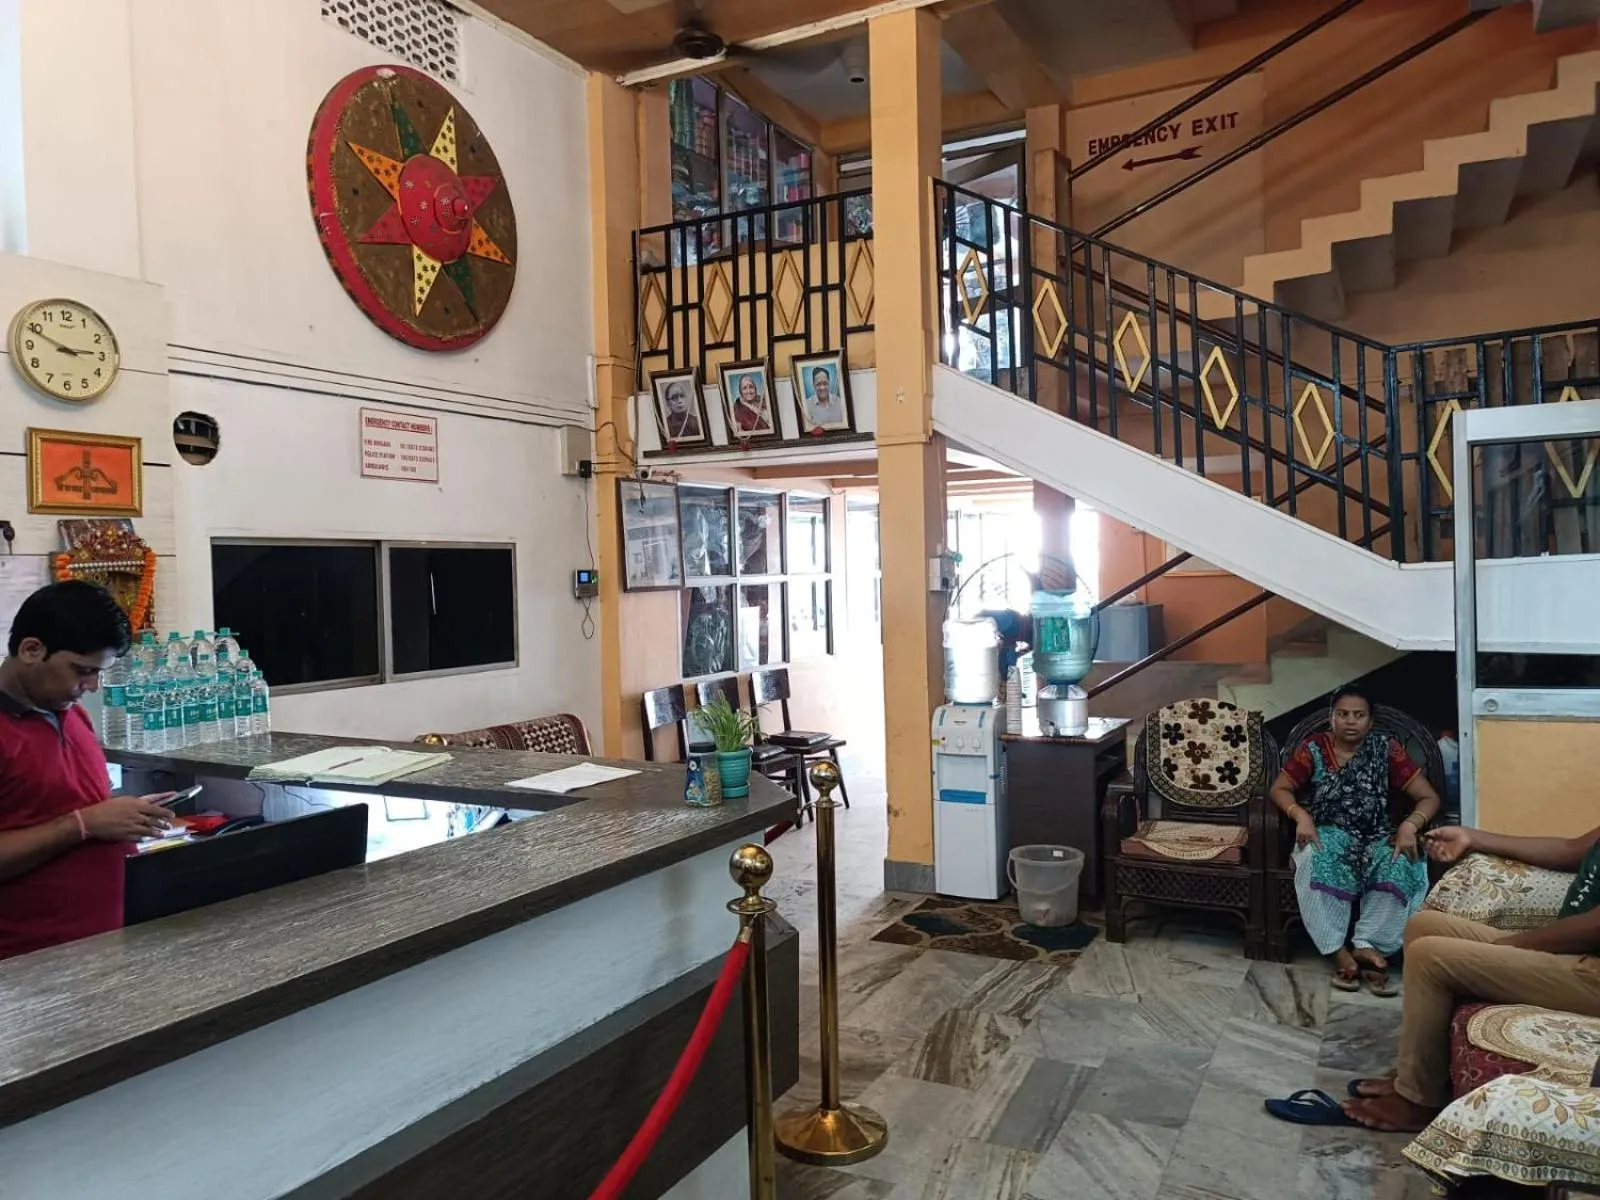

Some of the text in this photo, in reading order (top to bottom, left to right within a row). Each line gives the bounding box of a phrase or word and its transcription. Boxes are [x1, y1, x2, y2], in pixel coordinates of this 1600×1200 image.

[1192, 112, 1239, 136] EXIT
[42, 311, 53, 322] 11
[60, 310, 73, 322] 12
[29, 322, 43, 335] 10
[81, 318, 86, 328] 1
[94, 333, 101, 344] 2
[25, 339, 34, 350] 9
[99, 351, 105, 361] 3
[31, 357, 40, 368] 8
[45, 373, 54, 383] 7
[94, 368, 101, 377] 4
[63, 381, 71, 391] 6
[81, 378, 89, 389] 5
